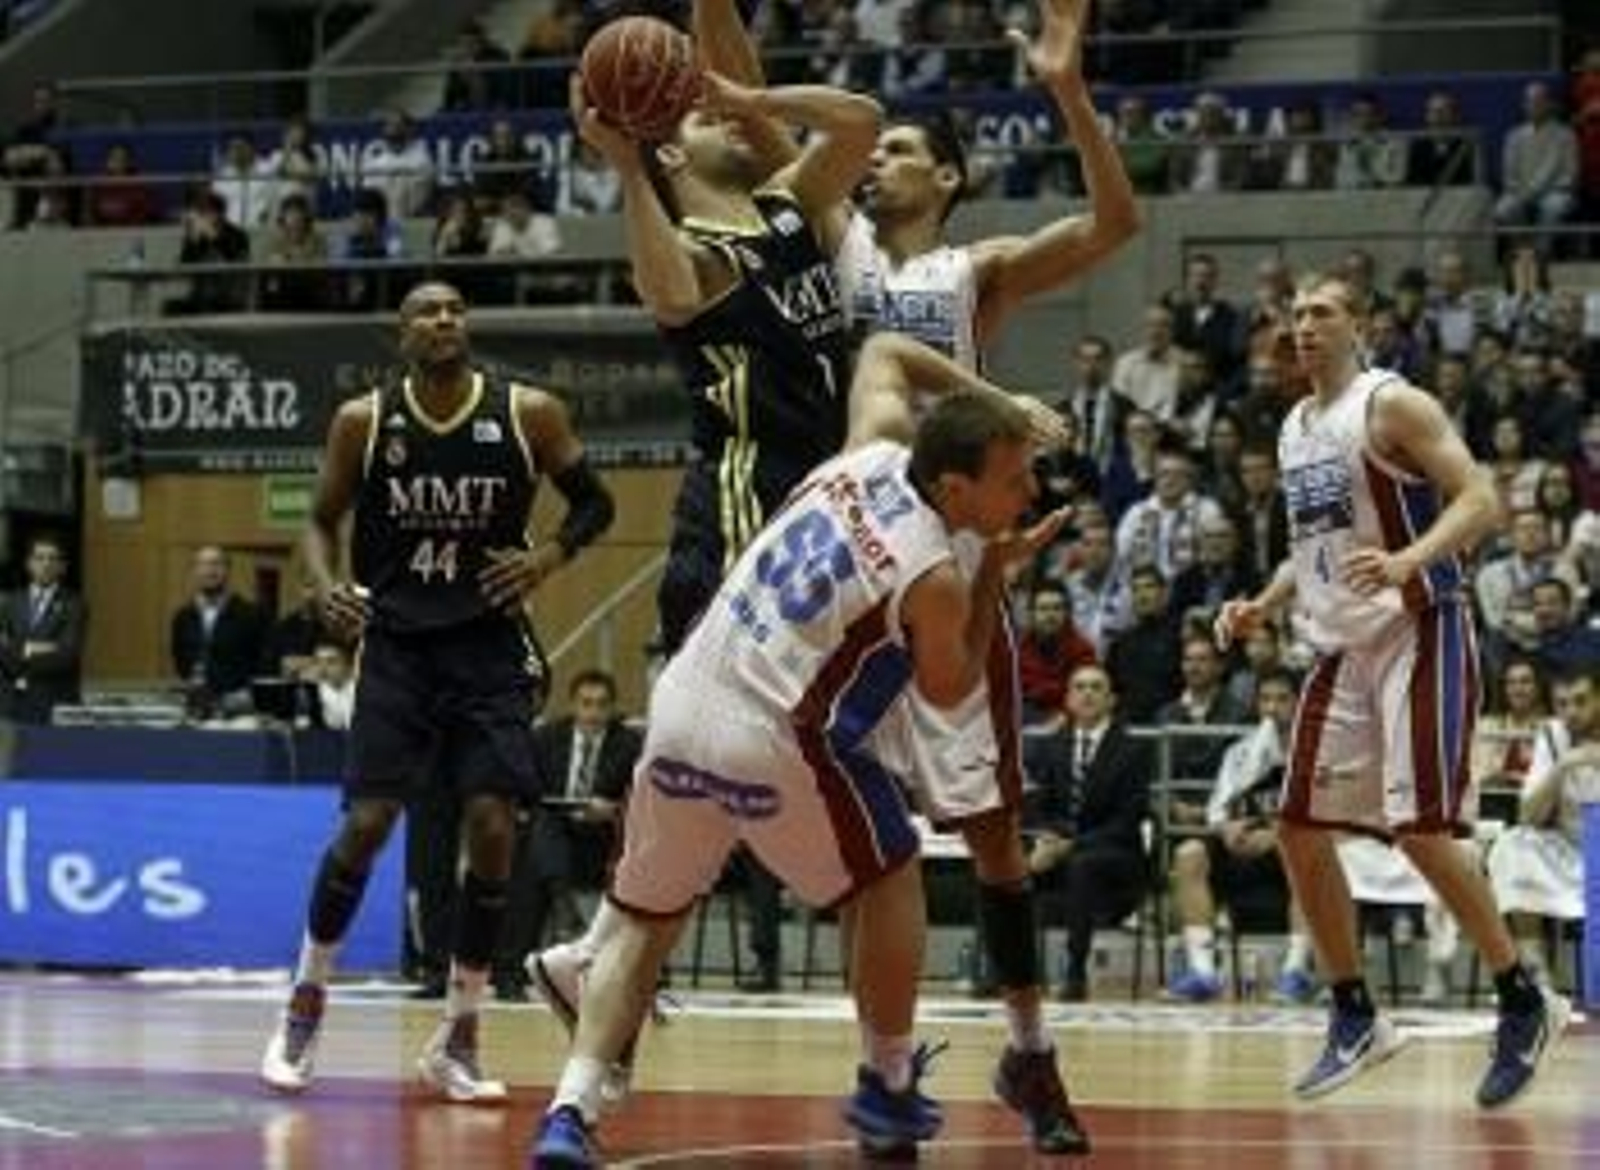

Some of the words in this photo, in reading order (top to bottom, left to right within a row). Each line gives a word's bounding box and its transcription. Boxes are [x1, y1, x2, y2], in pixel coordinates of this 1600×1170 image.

[387, 476, 507, 517] MMT
[409, 538, 459, 584] 44
[6, 806, 207, 919] les
